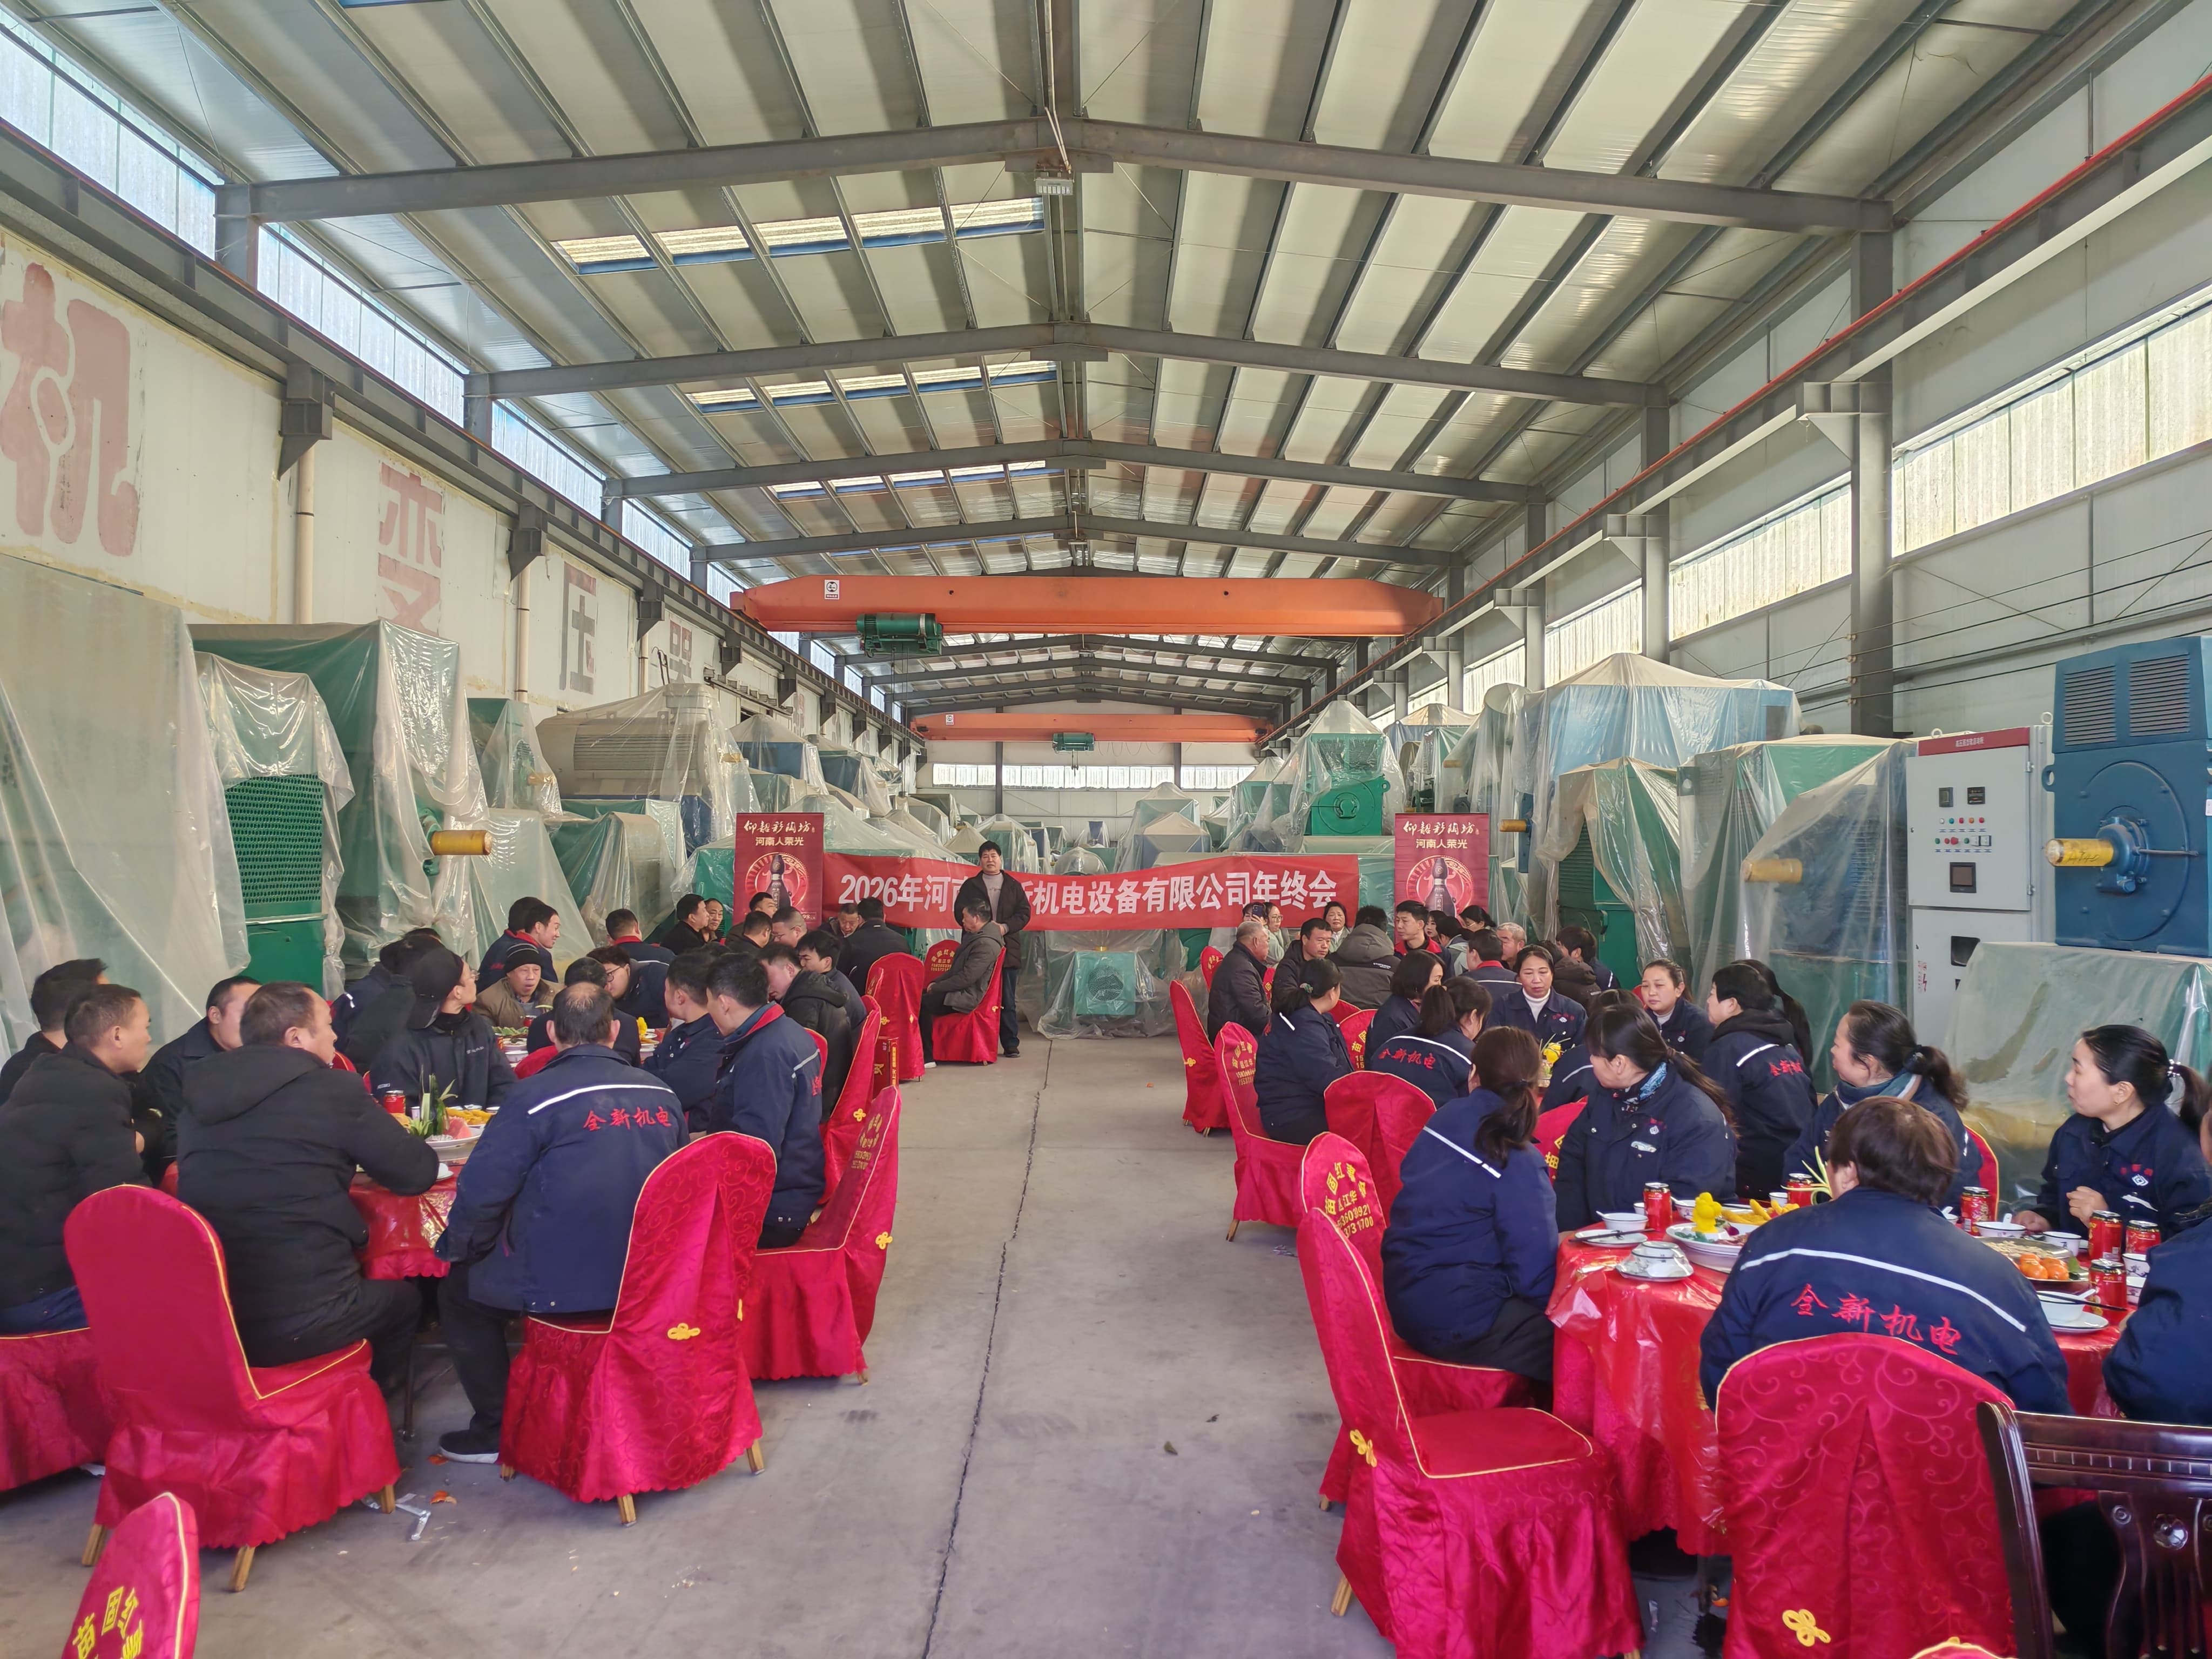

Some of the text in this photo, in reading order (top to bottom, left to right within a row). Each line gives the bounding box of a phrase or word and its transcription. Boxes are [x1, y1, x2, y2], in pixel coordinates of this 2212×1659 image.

[0, 262, 139, 557] 机
[559, 562, 596, 695] 压
[744, 820, 812, 834] 仰韶彩陶坊
[1403, 821, 1475, 837] 仰韶彩陶坊
[756, 837, 804, 846] 河南人荣光
[1416, 839, 1468, 849] 河南人荣光
[838, 869, 1337, 915] 2026年河机电设备有限公司年终会
[583, 1106, 672, 1131] 全新机电
[1791, 1283, 1961, 1355] 全新机电
